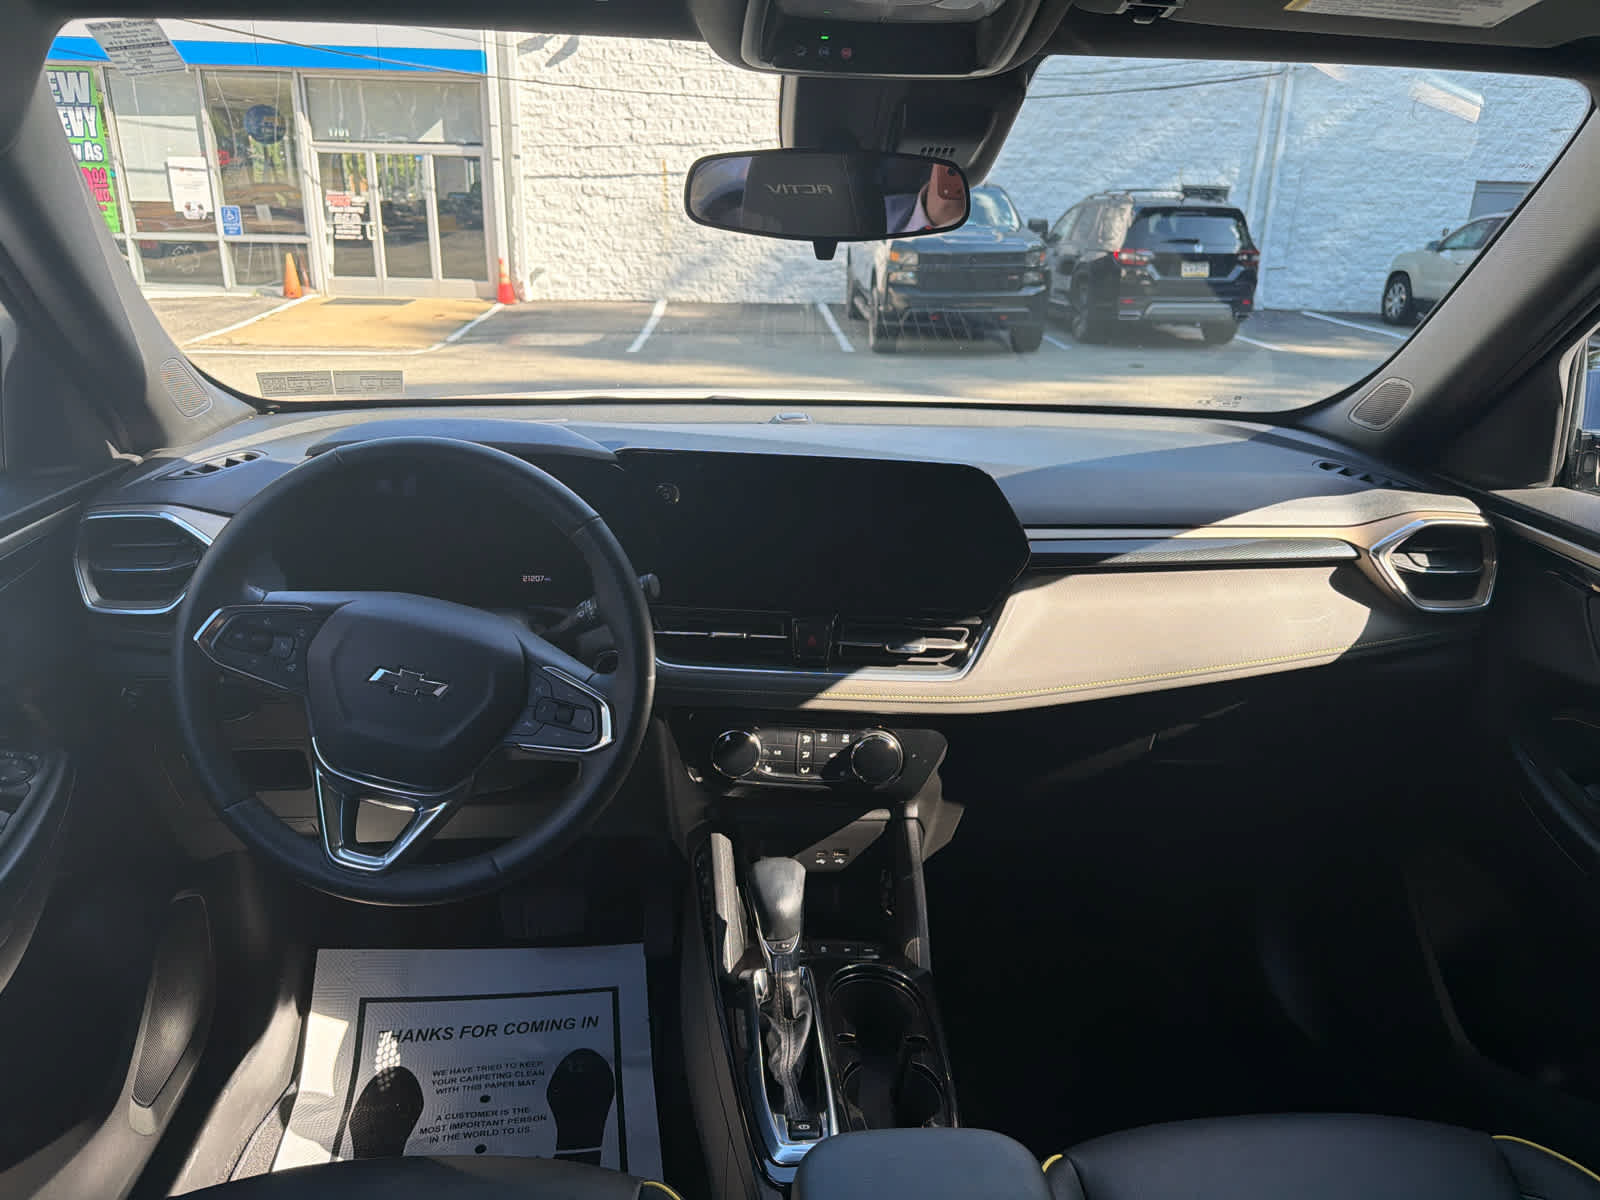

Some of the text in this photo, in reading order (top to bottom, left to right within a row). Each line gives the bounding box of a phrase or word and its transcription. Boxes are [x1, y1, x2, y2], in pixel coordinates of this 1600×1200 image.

[46, 71, 91, 104] EW
[379, 1015, 600, 1044] THANKS FOR COMING IN
[432, 1070, 546, 1087] YOUR CARPETING CLEAN
[449, 1067, 473, 1075] HAVE
[477, 1064, 503, 1072] TRIED
[435, 1087, 460, 1095] WITH
[484, 1081, 516, 1089] PAPER
[517, 1079, 537, 1087] MAT
[435, 1114, 443, 1123] A
[444, 1110, 499, 1121] CUSTOMER
[511, 1106, 530, 1114] THE
[419, 1113, 547, 1135] MOST IMPORTANT PERSON
[428, 1125, 532, 1145] IN THE WORLD TO US
